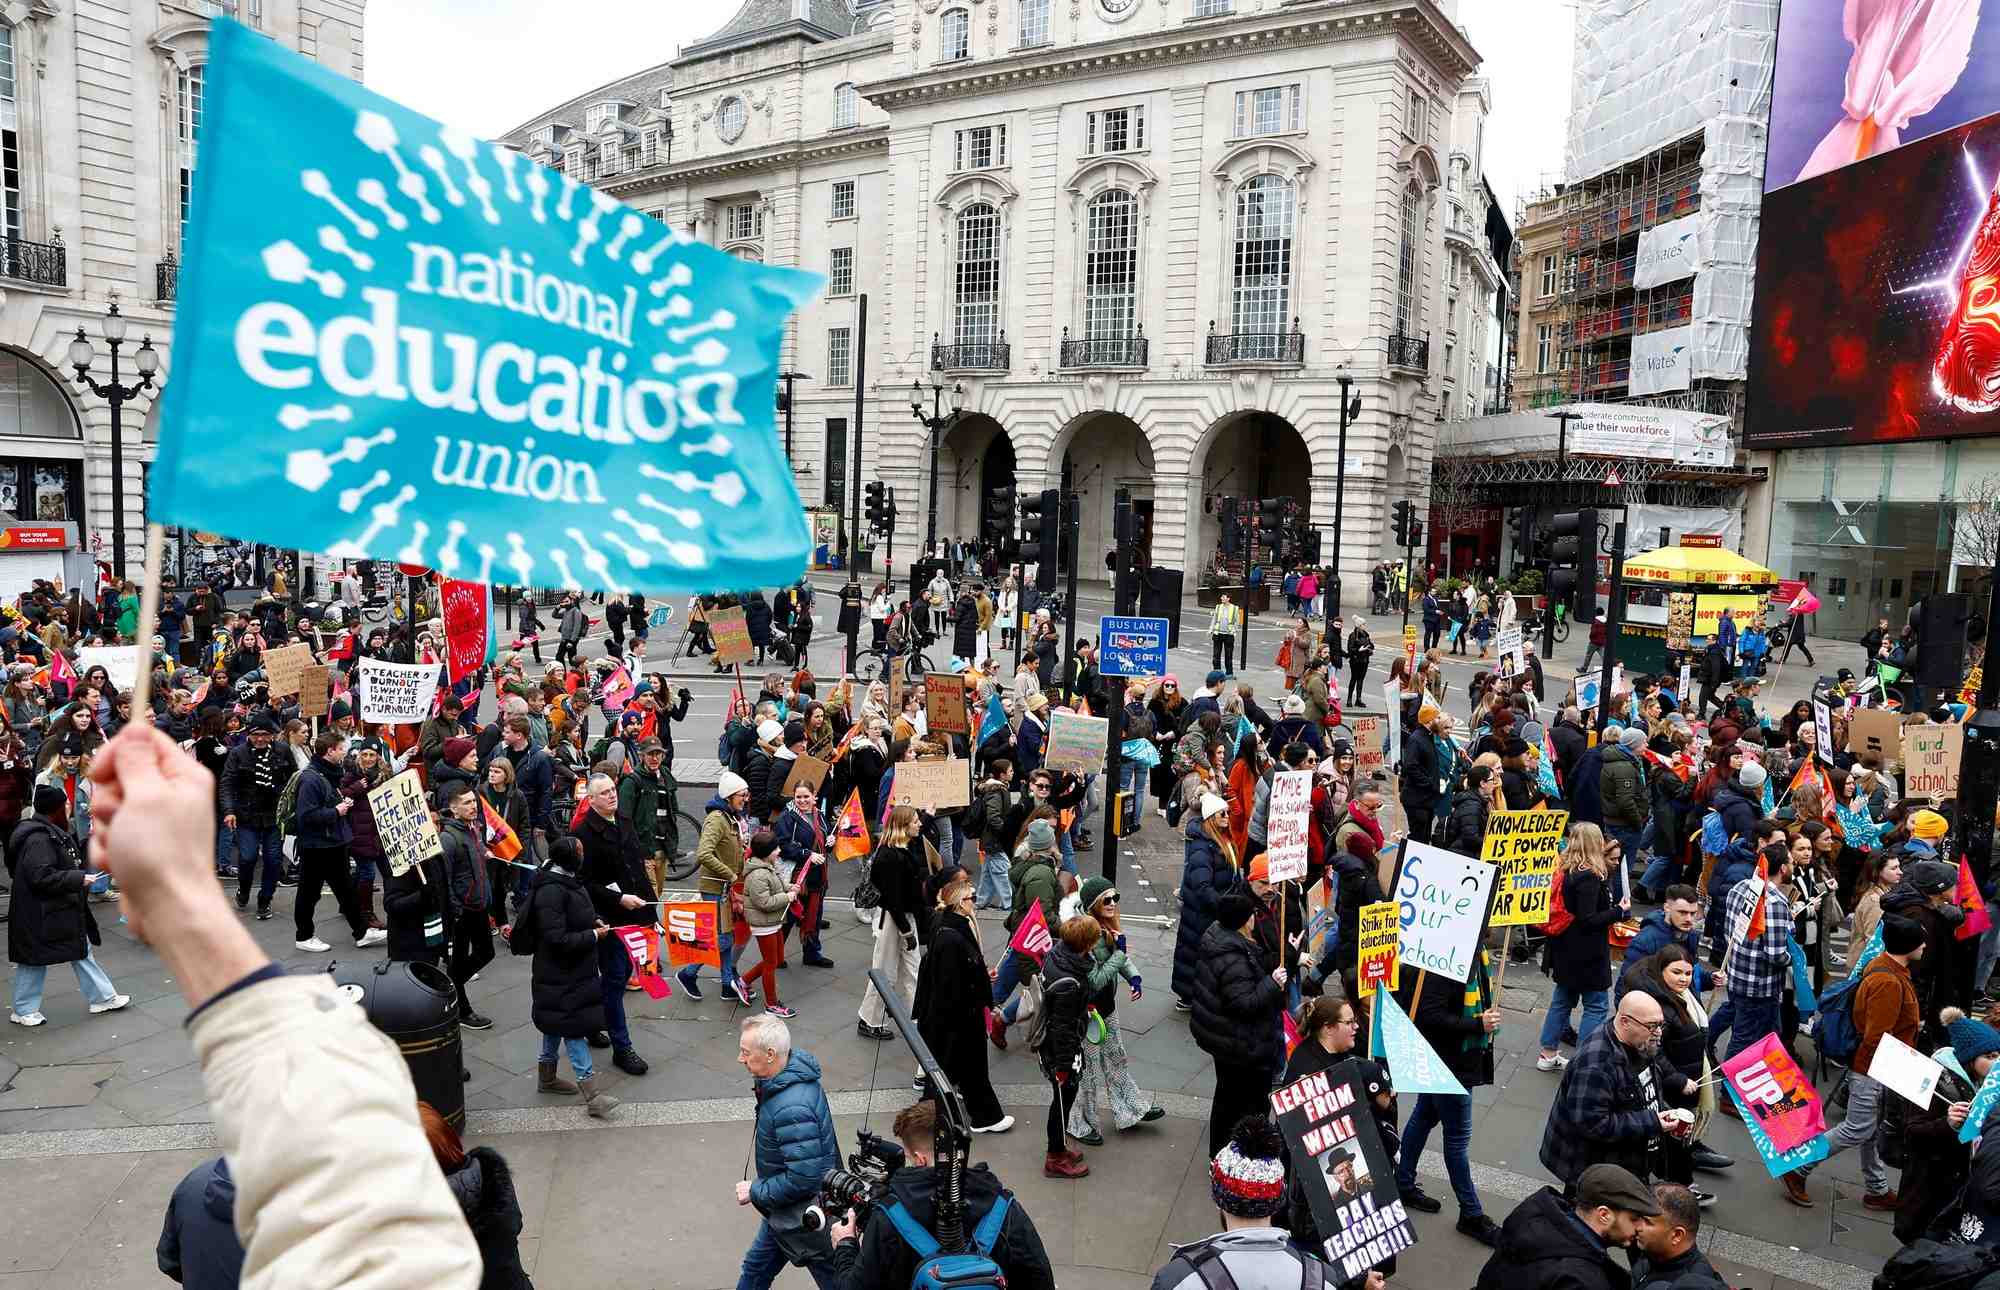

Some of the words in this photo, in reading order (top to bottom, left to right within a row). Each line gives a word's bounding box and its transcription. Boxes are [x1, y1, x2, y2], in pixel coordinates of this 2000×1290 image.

[406, 241, 639, 348] national
[234, 285, 745, 445] education
[1596, 423, 1619, 432] their
[1620, 425, 1670, 437] workforce
[431, 435, 607, 504] union
[1625, 567, 1645, 577] HOT
[1648, 569, 1670, 580] DOG
[1108, 620, 1130, 630] BUS
[1133, 621, 1161, 631] LANE
[1697, 611, 1718, 619] HOT
[371, 667, 420, 679] TEACHER
[370, 685, 379, 694] IS
[380, 687, 402, 696] WHY
[404, 687, 419, 696] WE
[397, 695, 417, 705] THIS
[927, 677, 962, 701] Standing
[1924, 750, 1949, 765] our
[1273, 775, 1282, 798] I
[1908, 767, 1960, 792] schools
[373, 789, 393, 815] IF
[401, 779, 412, 797] U
[1487, 814, 1565, 836] KNOWLEDGE
[1492, 839, 1508, 858] IS
[1532, 856, 1556, 870] WHY
[1400, 855, 1472, 917] Save
[1512, 873, 1551, 890] TORIES
[1520, 892, 1547, 913] US!
[668, 909, 696, 942] UP
[1361, 915, 1383, 934] Strike
[1385, 913, 1398, 930] for
[1399, 900, 1452, 930] Our
[1360, 931, 1398, 950] education
[1271, 1071, 1331, 1116] LEARN
[1735, 1059, 1784, 1106] UP
[1303, 1083, 1357, 1124] FROM
[1302, 1115, 1357, 1156] WALT
[1336, 1191, 1377, 1229] PAY
[1323, 1199, 1408, 1263] TEACHERS
[1341, 1224, 1415, 1280] MORE!!!
